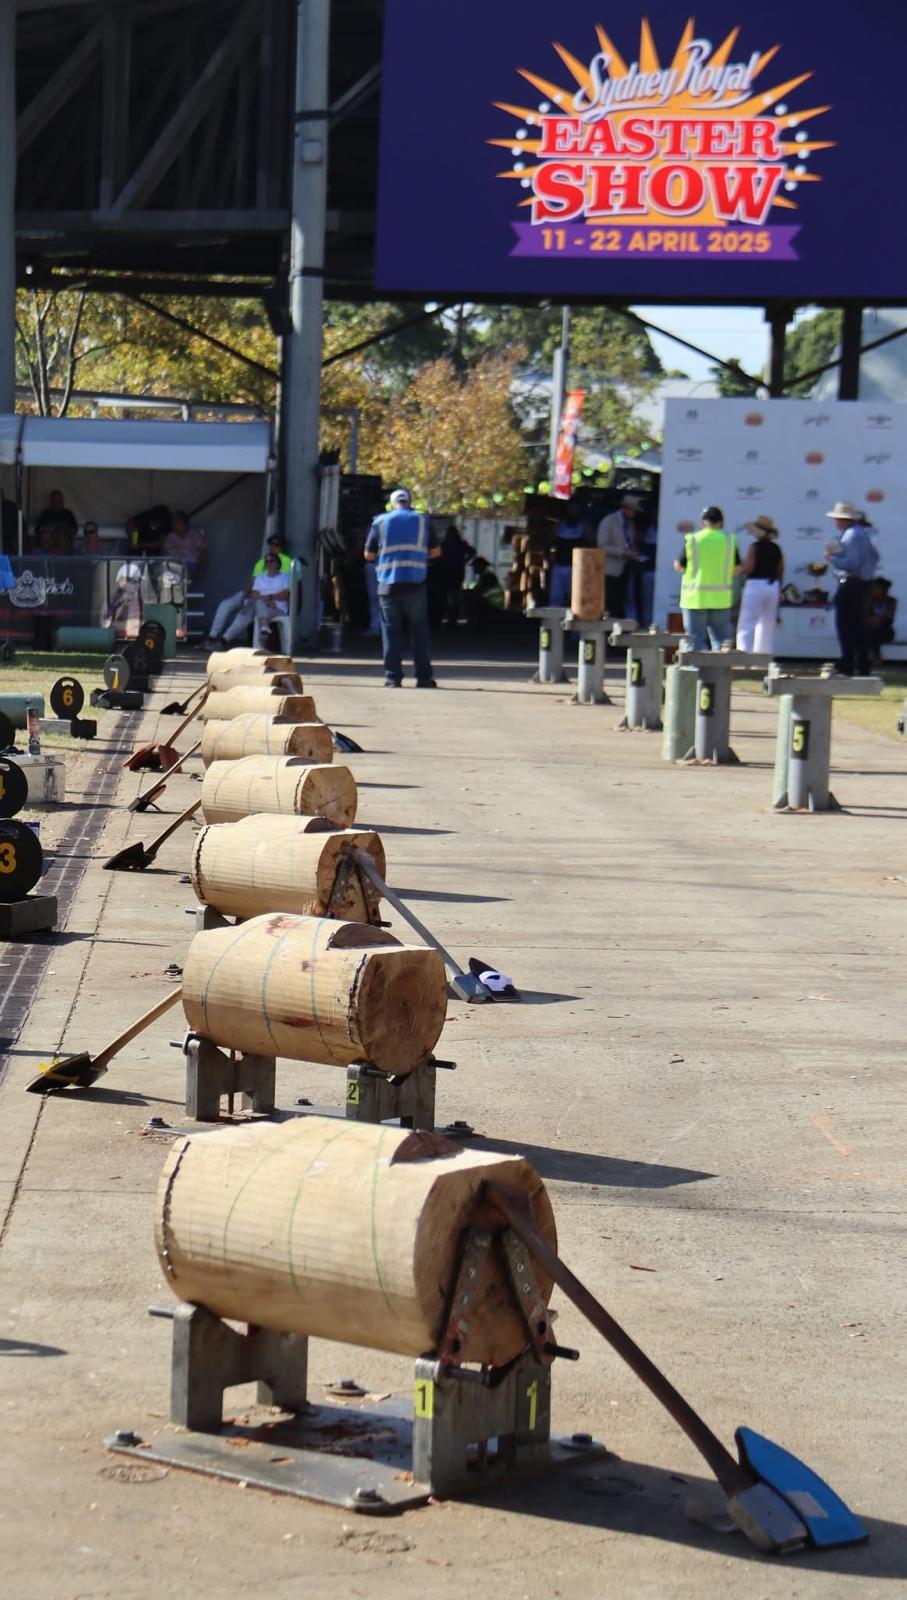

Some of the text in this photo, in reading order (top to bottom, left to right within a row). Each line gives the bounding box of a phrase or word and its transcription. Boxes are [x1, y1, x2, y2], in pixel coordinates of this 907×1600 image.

[573, 38, 762, 123] Sydney Royal
[537, 116, 784, 160] EASTER
[531, 161, 787, 225] SHOW
[541, 229, 567, 250] 11
[590, 230, 622, 251] 22
[627, 231, 700, 252] APRIL
[707, 232, 771, 253] 2025
[630, 661, 640, 682] 7
[63, 688, 74, 706] 6
[700, 687, 710, 711] 6
[792, 724, 804, 752] 5
[0, 842, 17, 874] 3
[348, 1082, 356, 1100] 2
[417, 1379, 538, 1430] 1 1
